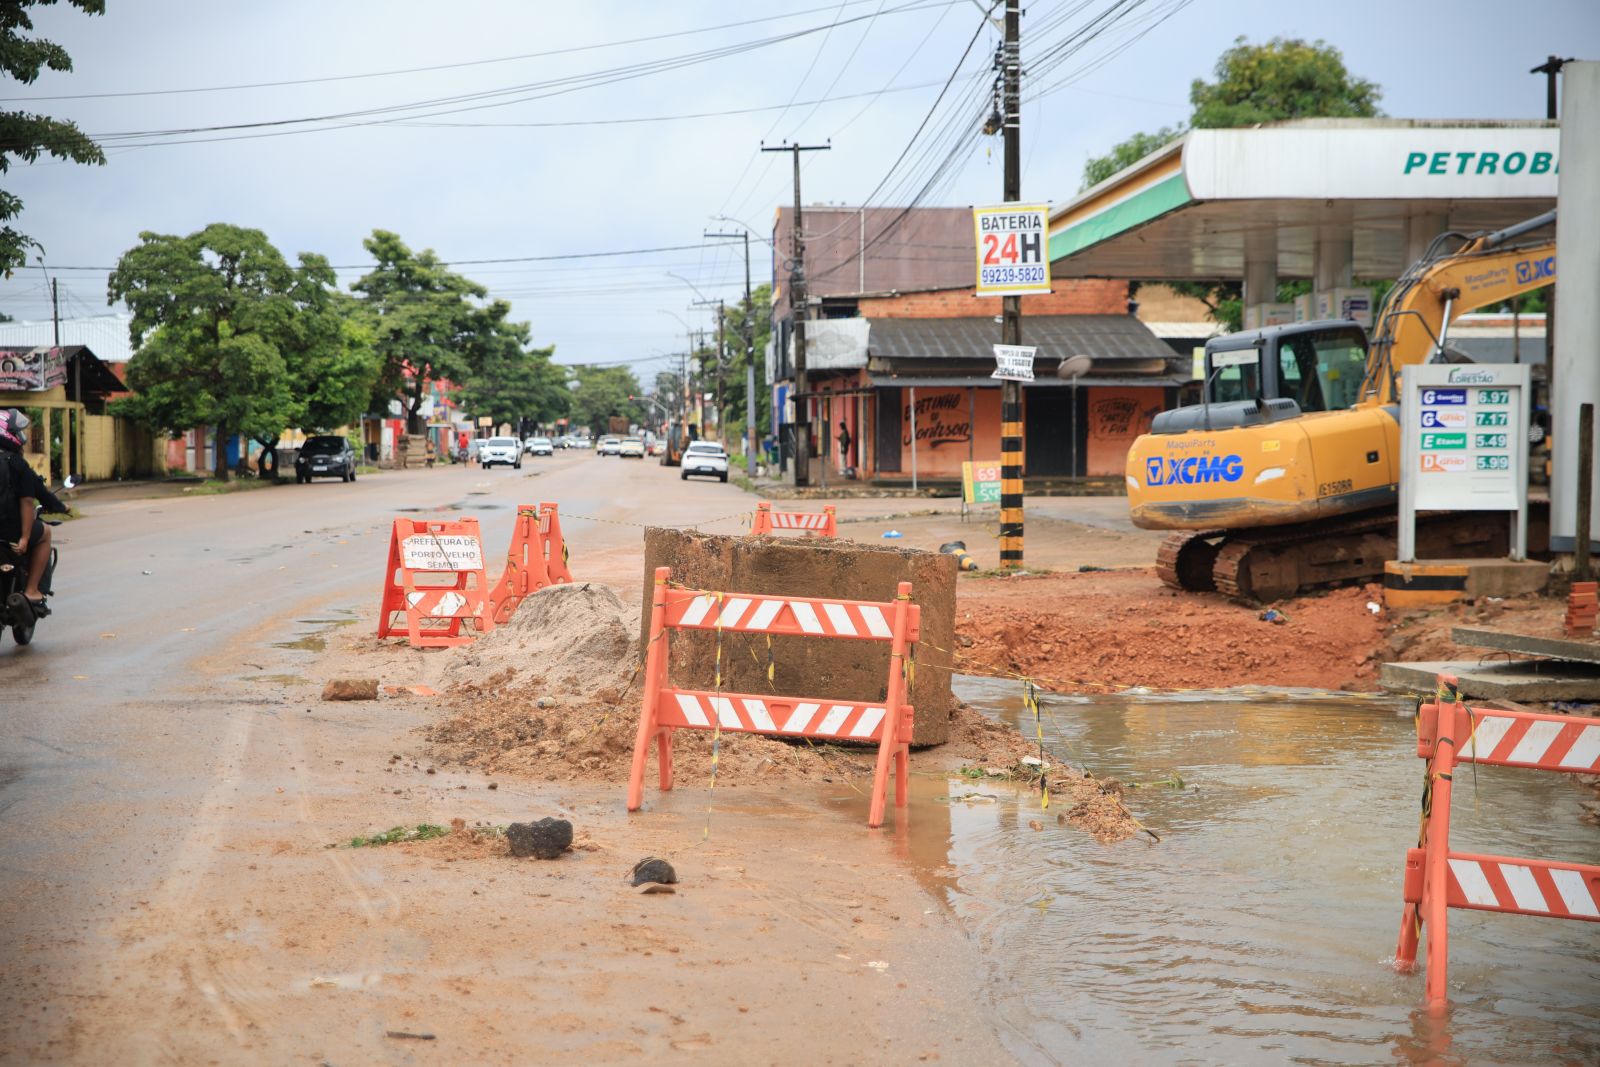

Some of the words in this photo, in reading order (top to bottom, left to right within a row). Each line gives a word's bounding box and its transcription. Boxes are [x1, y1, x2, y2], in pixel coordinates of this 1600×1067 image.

[1403, 151, 1559, 175] PETROB
[981, 215, 1041, 230] BATERIA
[983, 233, 1041, 265] 24H
[982, 267, 1044, 282] 99239-5820
[1534, 256, 1557, 280] XC
[1423, 391, 1436, 404] G
[1479, 391, 1508, 404] 6.97
[904, 393, 961, 422] EPETINHO
[1422, 412, 1436, 427] G
[1476, 412, 1507, 426] 7.17
[1167, 439, 1216, 450] MaquiParts
[1423, 435, 1435, 448] E
[1476, 435, 1507, 447] 5.49
[1165, 455, 1245, 485] XCMG
[1477, 456, 1508, 469] 5.99
[410, 538, 462, 546] PREFETURA
[446, 551, 475, 559] VELHO
[427, 561, 459, 569] SEMOB
